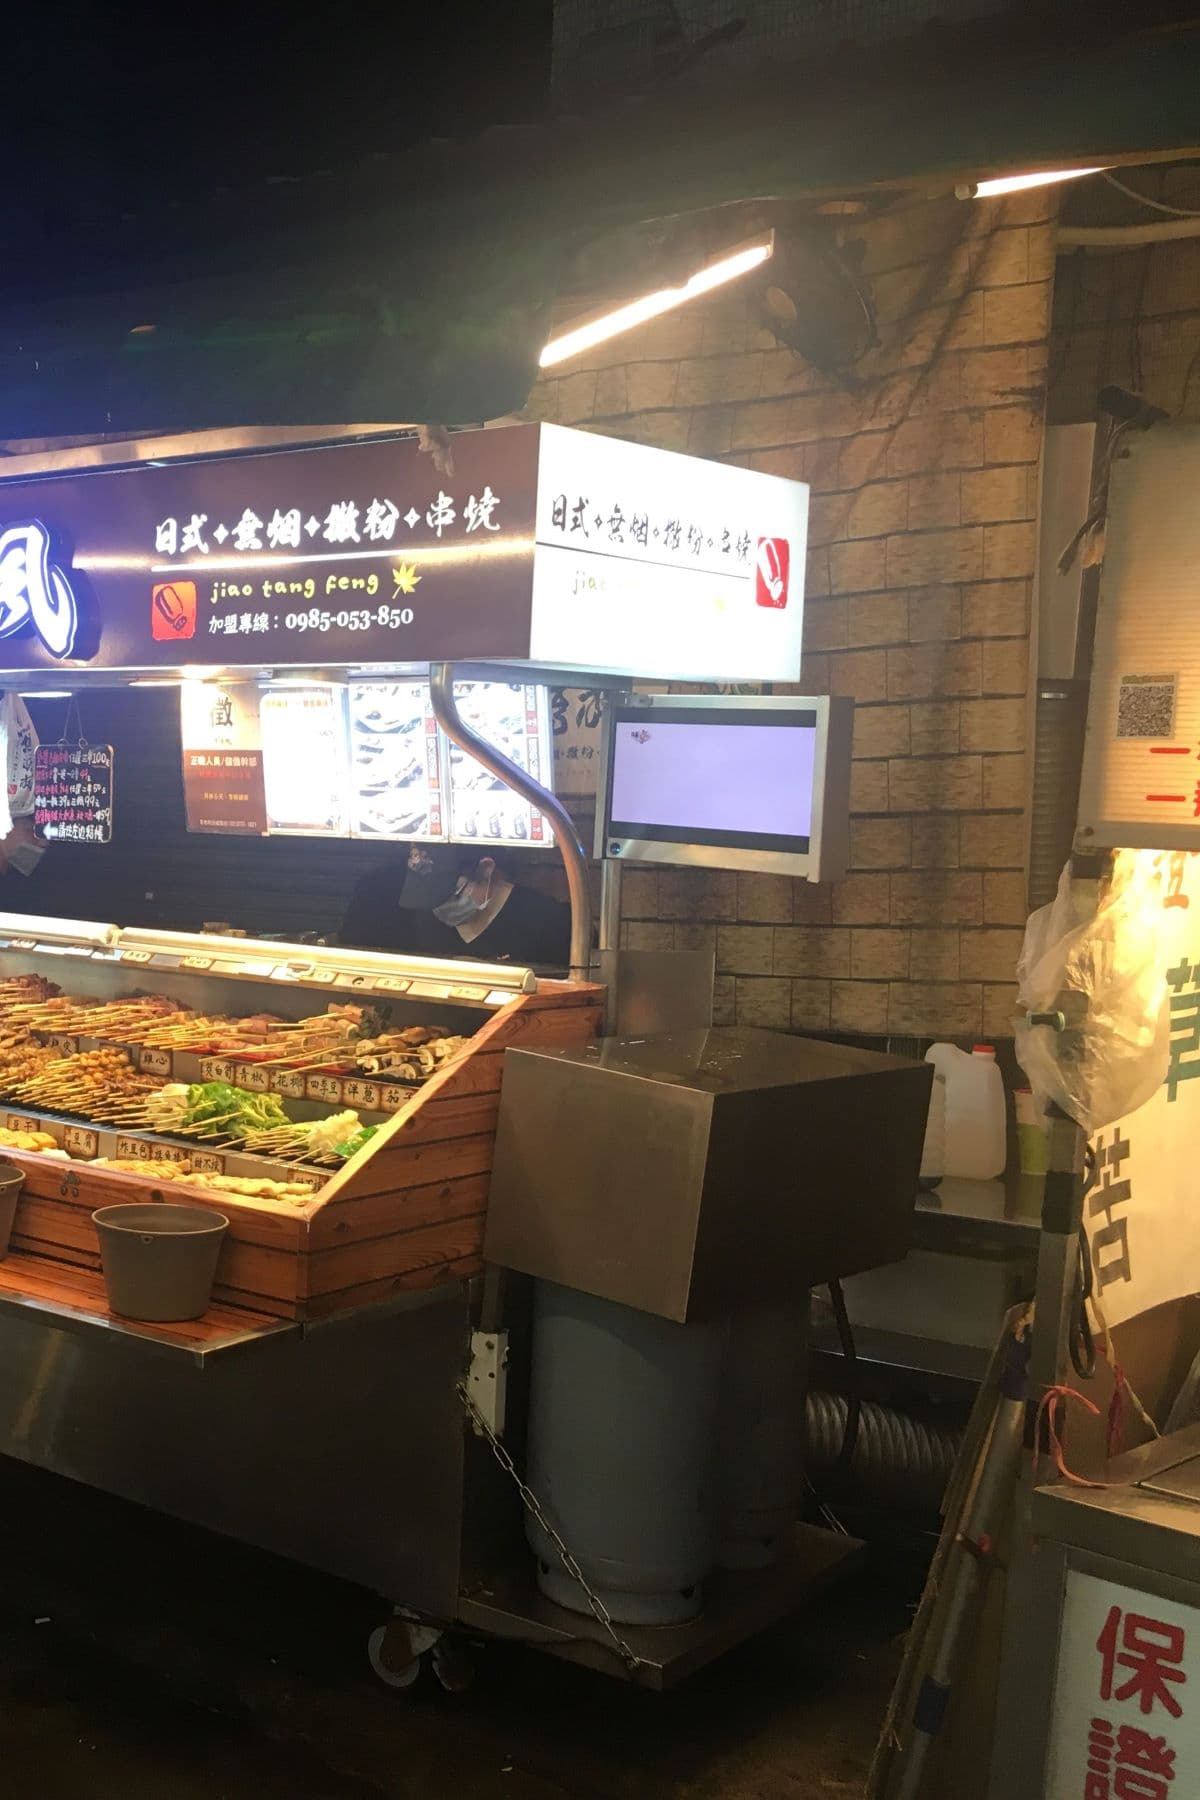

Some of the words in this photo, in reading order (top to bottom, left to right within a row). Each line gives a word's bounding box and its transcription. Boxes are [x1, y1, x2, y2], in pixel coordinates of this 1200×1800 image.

[155, 514, 209, 554] 日式
[426, 487, 500, 537] 串燒
[552, 494, 590, 538] 日式
[211, 582, 253, 603] jiao
[263, 579, 315, 598] tang
[326, 574, 379, 595] feng
[240, 1067, 265, 1083] 青椒
[311, 1078, 338, 1096] 四季豆
